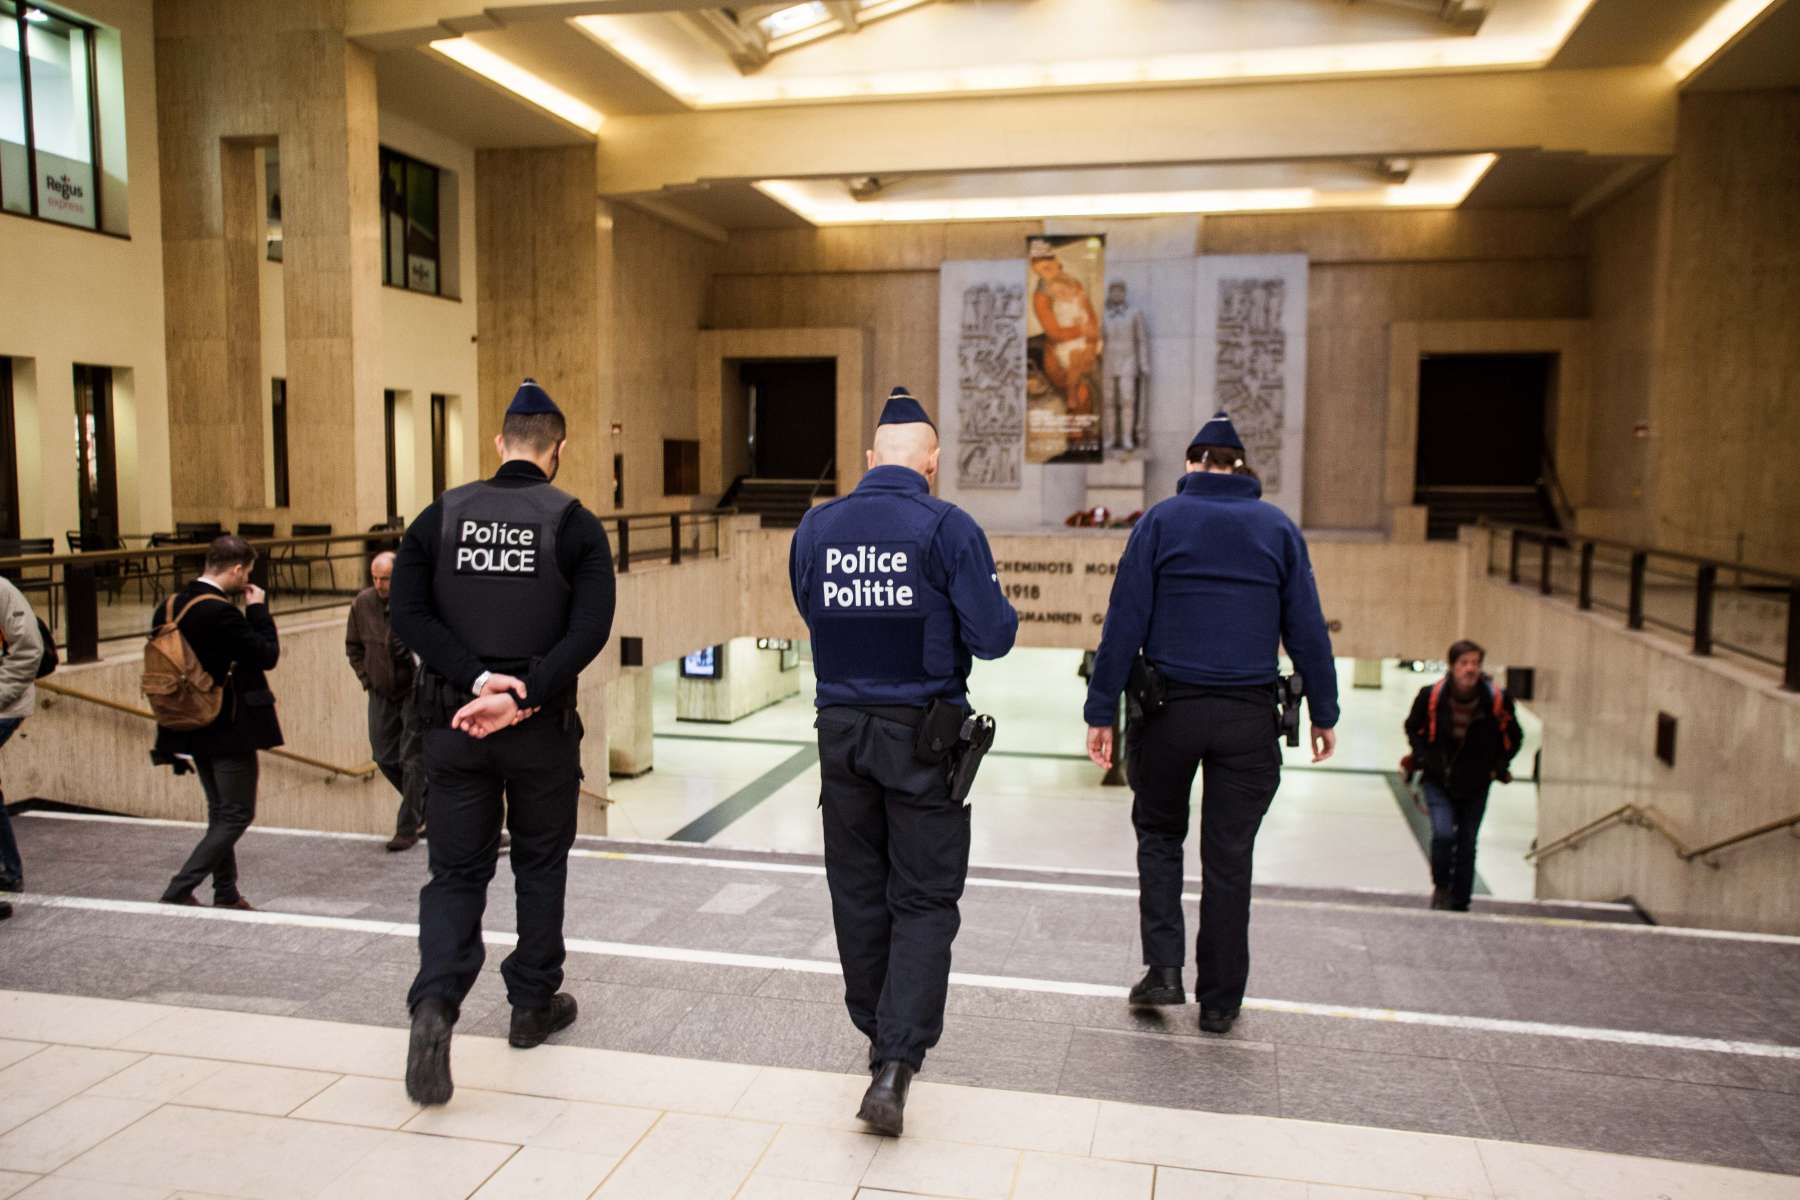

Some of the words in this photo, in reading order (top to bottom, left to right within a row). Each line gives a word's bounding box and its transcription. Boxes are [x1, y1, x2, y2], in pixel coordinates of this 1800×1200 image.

[47, 174, 84, 200] Regus
[462, 521, 534, 546] Police
[457, 547, 536, 572] POLICE
[826, 545, 908, 574] Police
[823, 579, 913, 608] Politie
[1005, 585, 1041, 600] 1918
